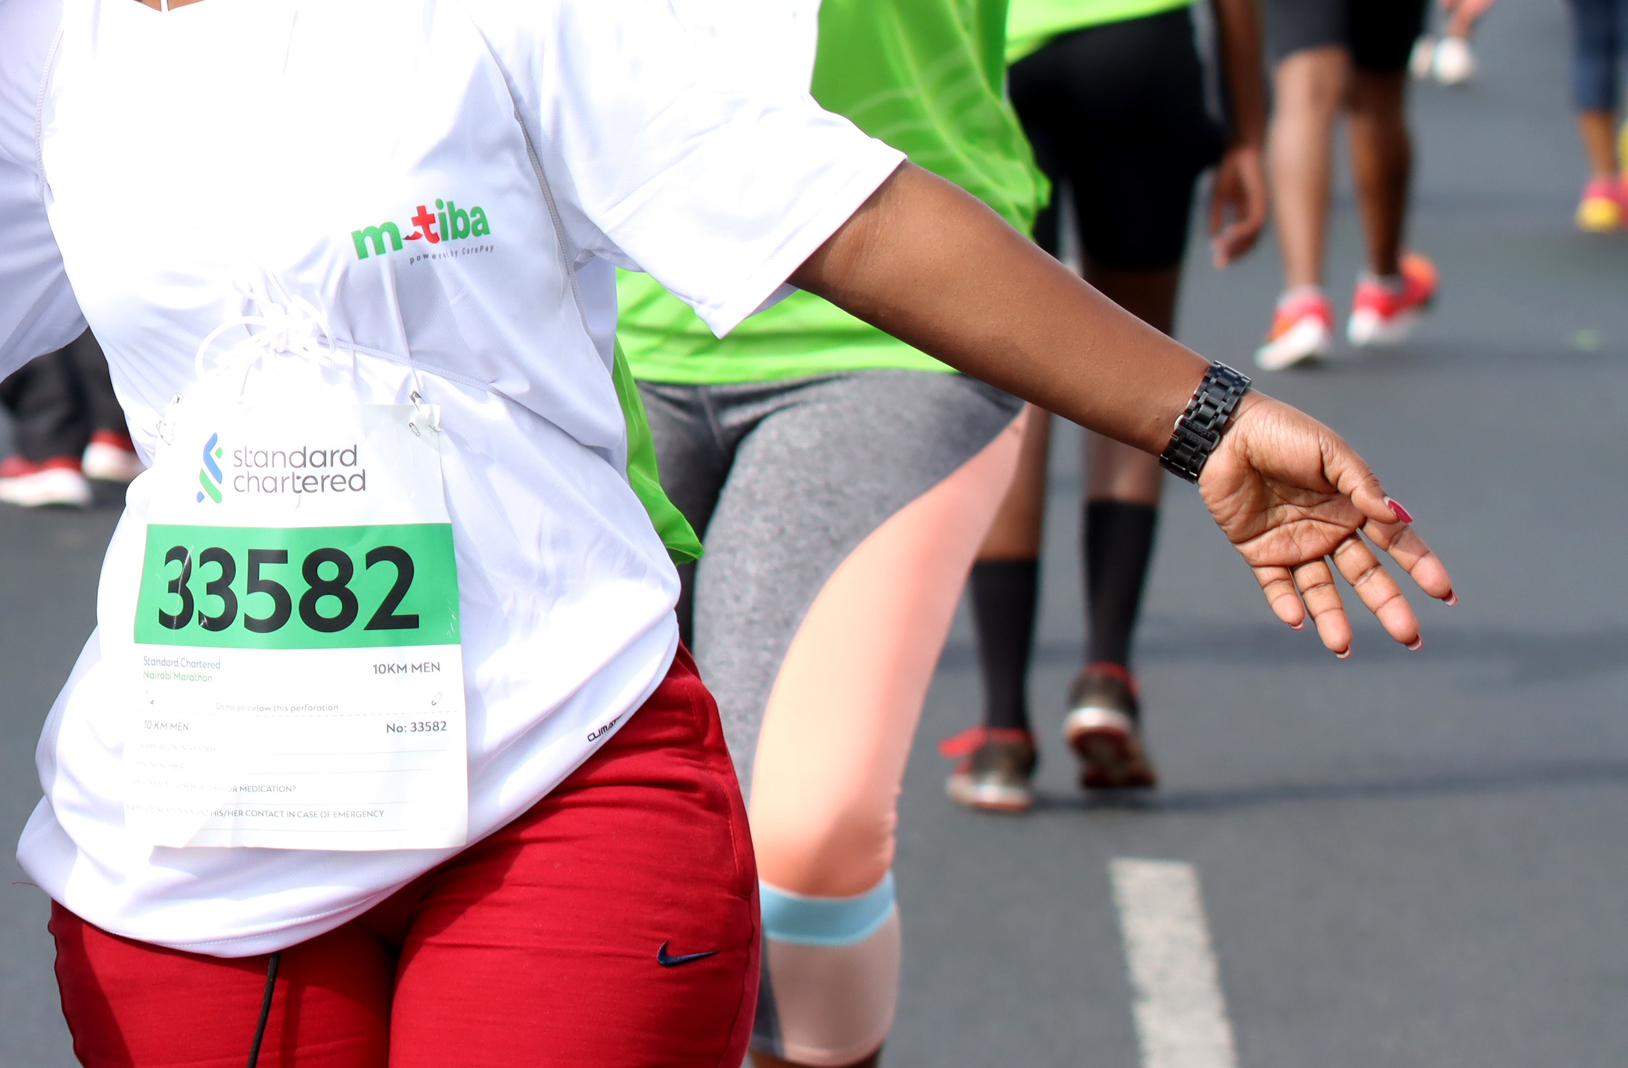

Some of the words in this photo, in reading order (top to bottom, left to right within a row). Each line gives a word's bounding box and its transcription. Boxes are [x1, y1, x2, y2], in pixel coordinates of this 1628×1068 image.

[461, 244, 494, 256] CarePay
[233, 443, 357, 468] standard
[233, 469, 366, 494] chartered
[159, 545, 420, 633] 33582
[143, 655, 179, 667] Standard
[180, 657, 221, 670] Chartered
[372, 663, 408, 675] 10KM
[411, 661, 440, 674] MEN
[142, 669, 172, 681] Nairobi
[173, 671, 213, 683] Marathon
[273, 703, 289, 712] this
[290, 703, 339, 713] perforation
[143, 720, 153, 730] 10
[153, 720, 168, 730] KM
[169, 721, 189, 732] MEN
[386, 722, 407, 734] No:
[410, 720, 448, 733] 33582
[239, 784, 297, 793] MEDICATION?
[210, 809, 244, 818] HIS/HER
[245, 809, 284, 818] CONTACT
[286, 810, 295, 818] IN
[297, 810, 318, 819] CASE
[319, 810, 332, 819] OF
[333, 809, 385, 819] EMERGENCY
